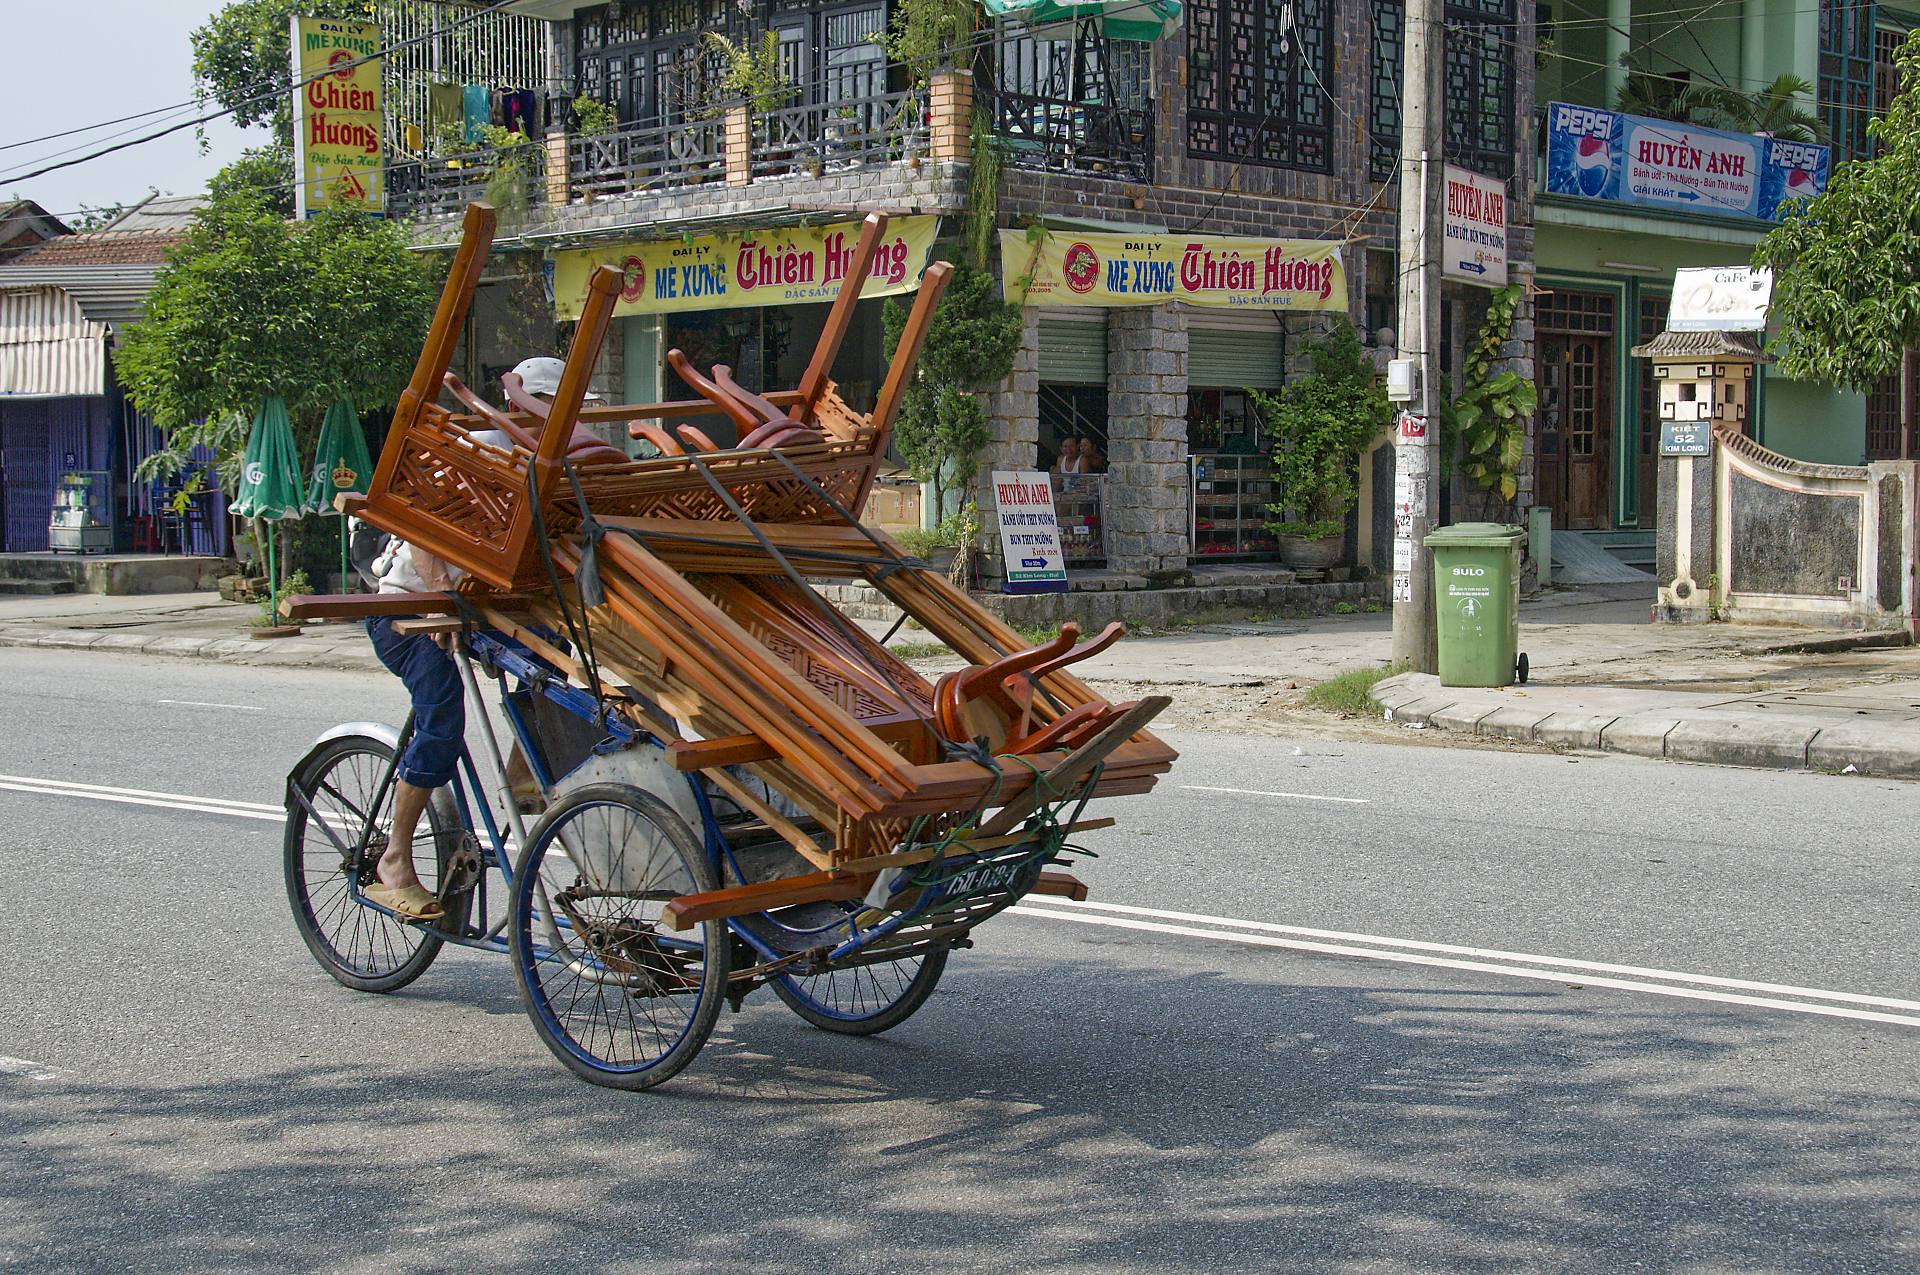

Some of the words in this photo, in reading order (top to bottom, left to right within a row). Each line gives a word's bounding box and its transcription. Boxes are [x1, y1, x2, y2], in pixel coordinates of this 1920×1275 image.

[306, 32, 329, 52] MÈ
[320, 23, 342, 33] ĐẠI
[308, 74, 375, 111] Thiên
[310, 112, 379, 153] Hương
[1556, 107, 1614, 140] PEPSI
[1638, 134, 1703, 171] HUYỀN
[1706, 151, 1746, 177] ANH
[1769, 142, 1821, 171] PEPSI
[1448, 174, 1482, 222] HUYỀN
[1483, 190, 1504, 229] ANH
[1652, 187, 1676, 198] KHÁT
[673, 247, 693, 257] ĐẠI
[1125, 242, 1144, 251] ĐẠI
[655, 260, 677, 299] MÈ
[736, 239, 816, 291] Thiên
[1107, 253, 1130, 292] MÈ
[1180, 242, 1257, 293] Thiên
[1261, 245, 1335, 301] Hương
[1715, 272, 1747, 283] CaFe
[1674, 434, 1695, 443] 52
[997, 473, 1032, 506] HUYỀN
[1031, 484, 1051, 505] ANH
[1453, 568, 1485, 576] SULO
